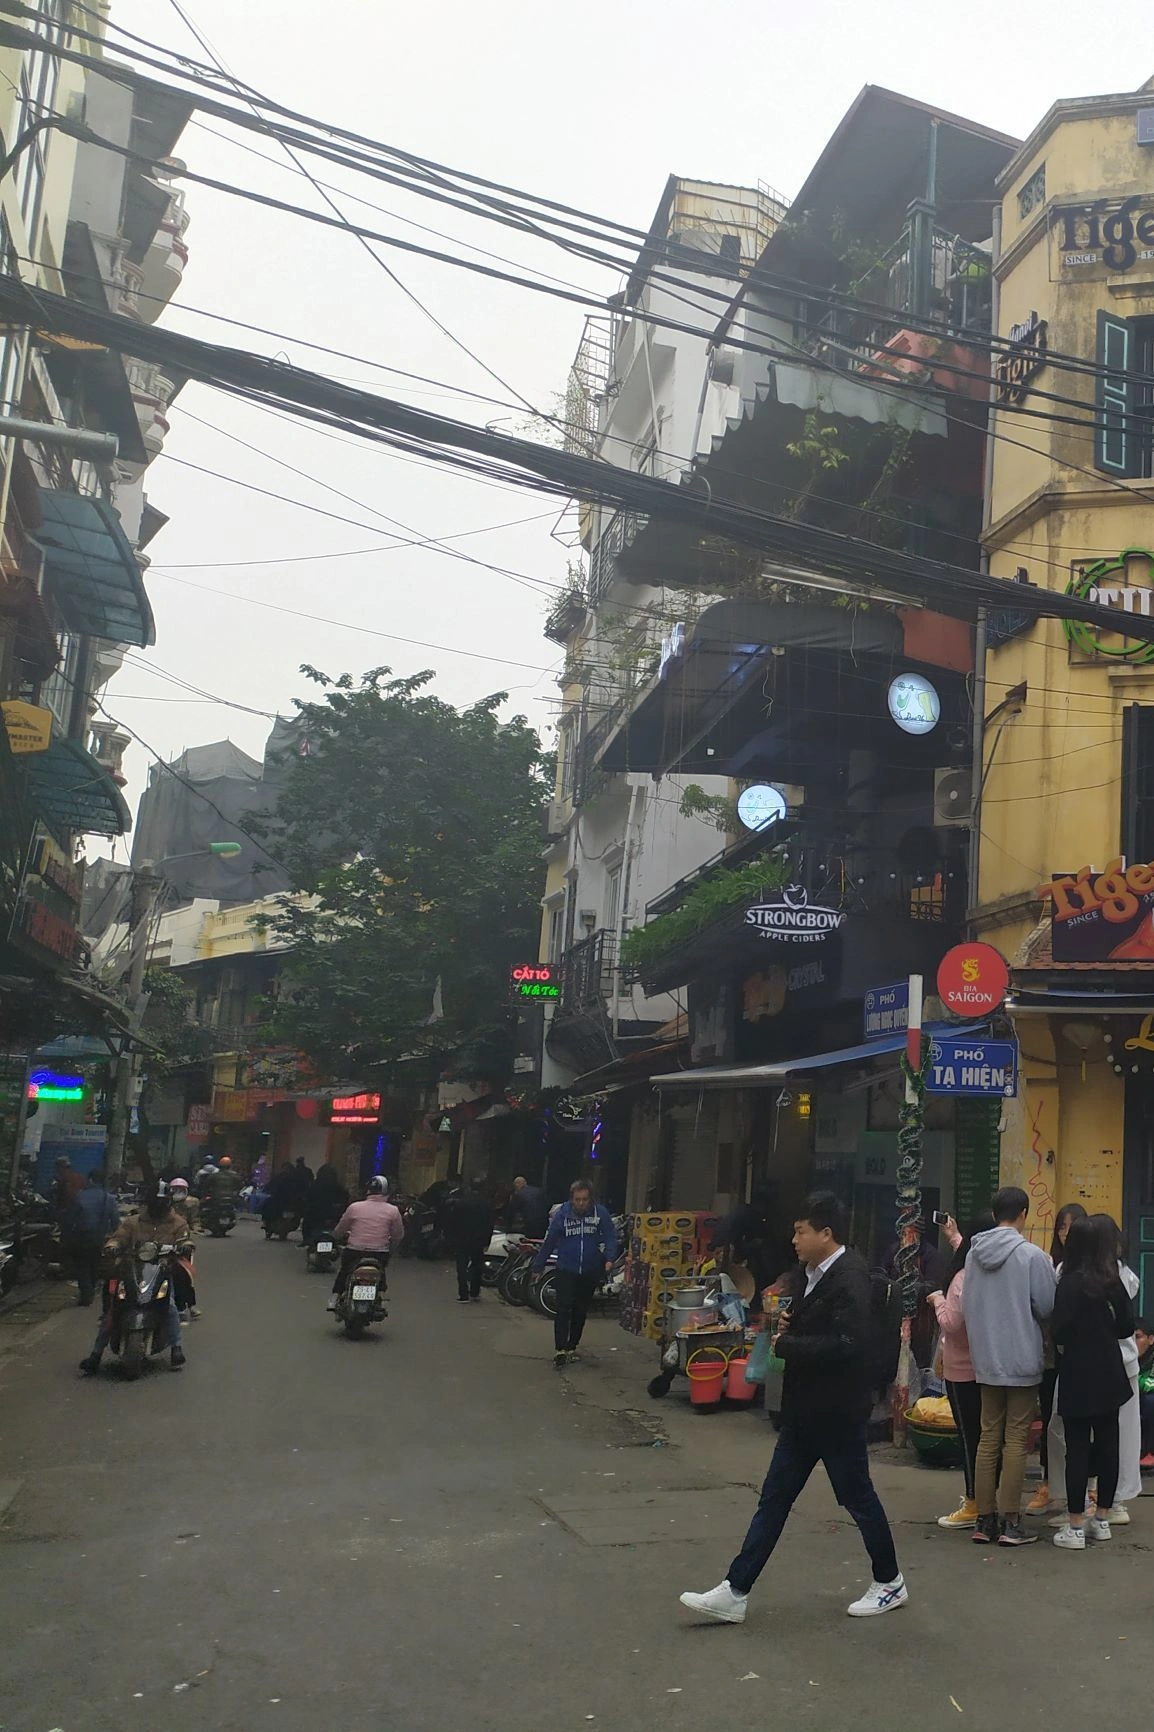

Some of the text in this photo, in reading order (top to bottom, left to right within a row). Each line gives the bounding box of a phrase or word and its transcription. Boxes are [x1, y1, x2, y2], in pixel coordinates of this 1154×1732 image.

[1066, 253, 1096, 265] SINCE
[746, 909, 842, 929] STRONGBOW
[1066, 910, 1099, 927] SINCE
[760, 930, 826, 943] APPLE CIDERS
[879, 988, 896, 1006] PHỐ
[948, 991, 992, 1003] SAIGON
[954, 1046, 984, 1060] PHỐ
[933, 1064, 1005, 1090] TẠ HIỆN
